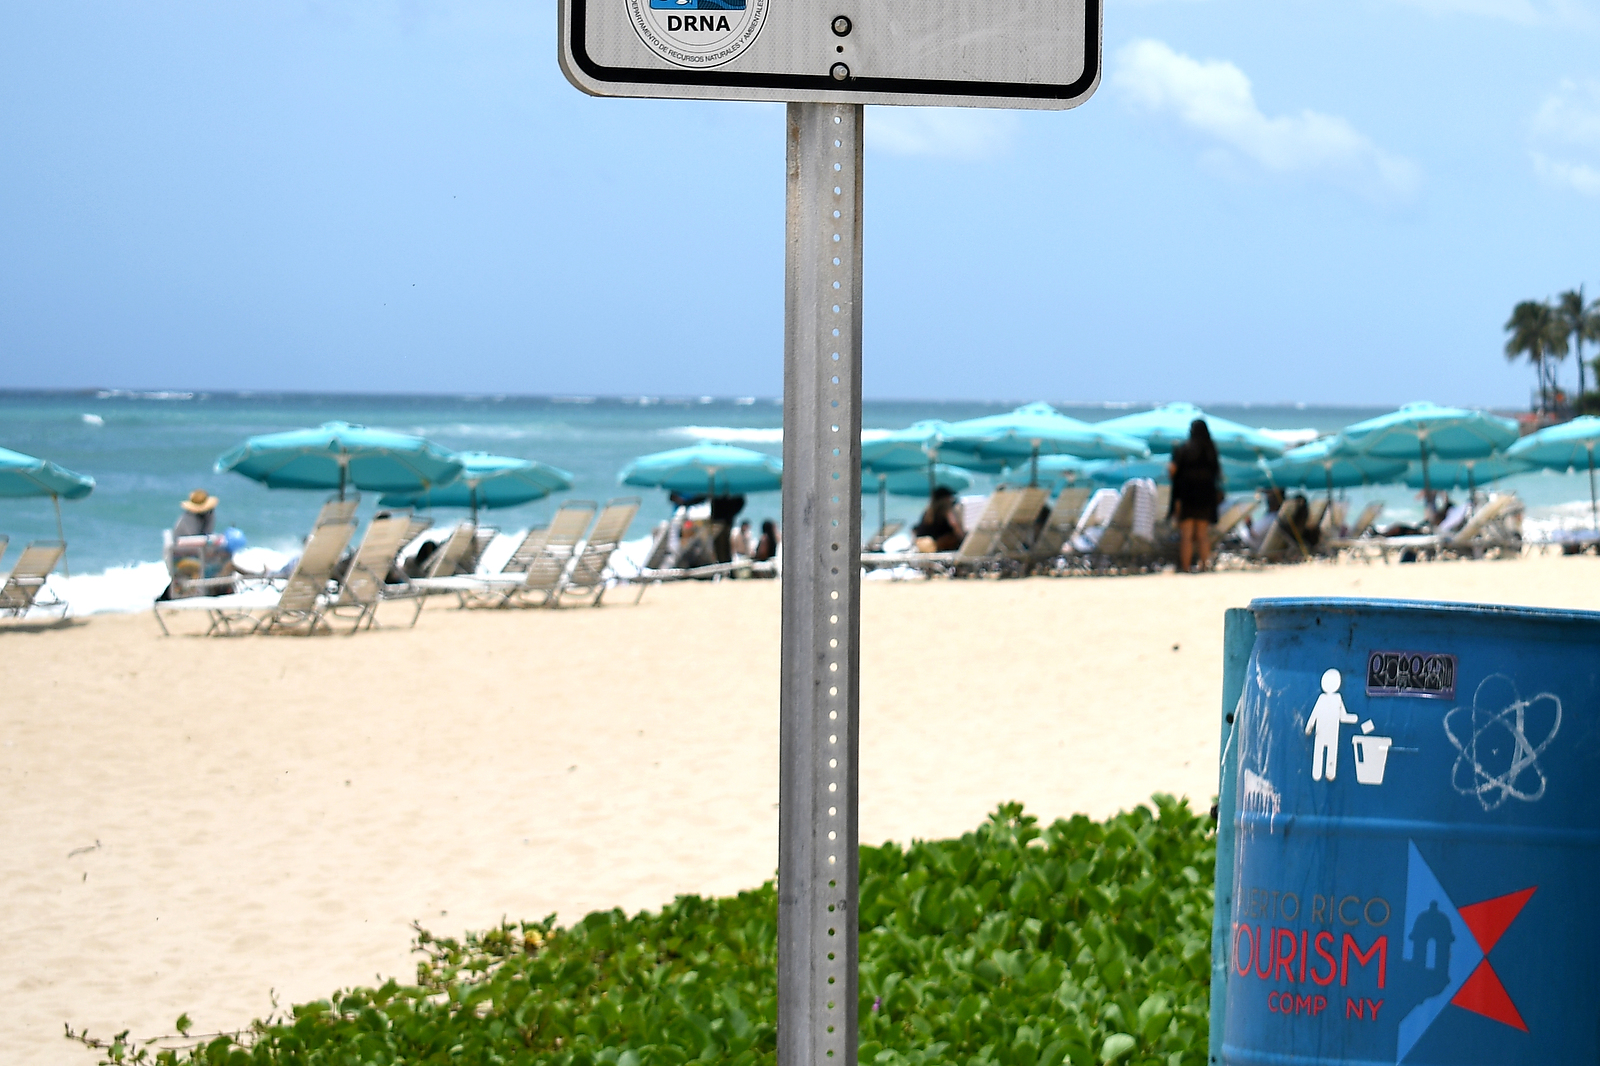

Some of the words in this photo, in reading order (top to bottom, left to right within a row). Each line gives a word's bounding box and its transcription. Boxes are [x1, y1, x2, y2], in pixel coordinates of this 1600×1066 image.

[667, 15, 731, 32] DRNA
[658, 43, 669, 53] DE
[668, 49, 705, 63] RECURSOS
[705, 43, 741, 62] NATURALES
[1311, 894, 1391, 927] RICO
